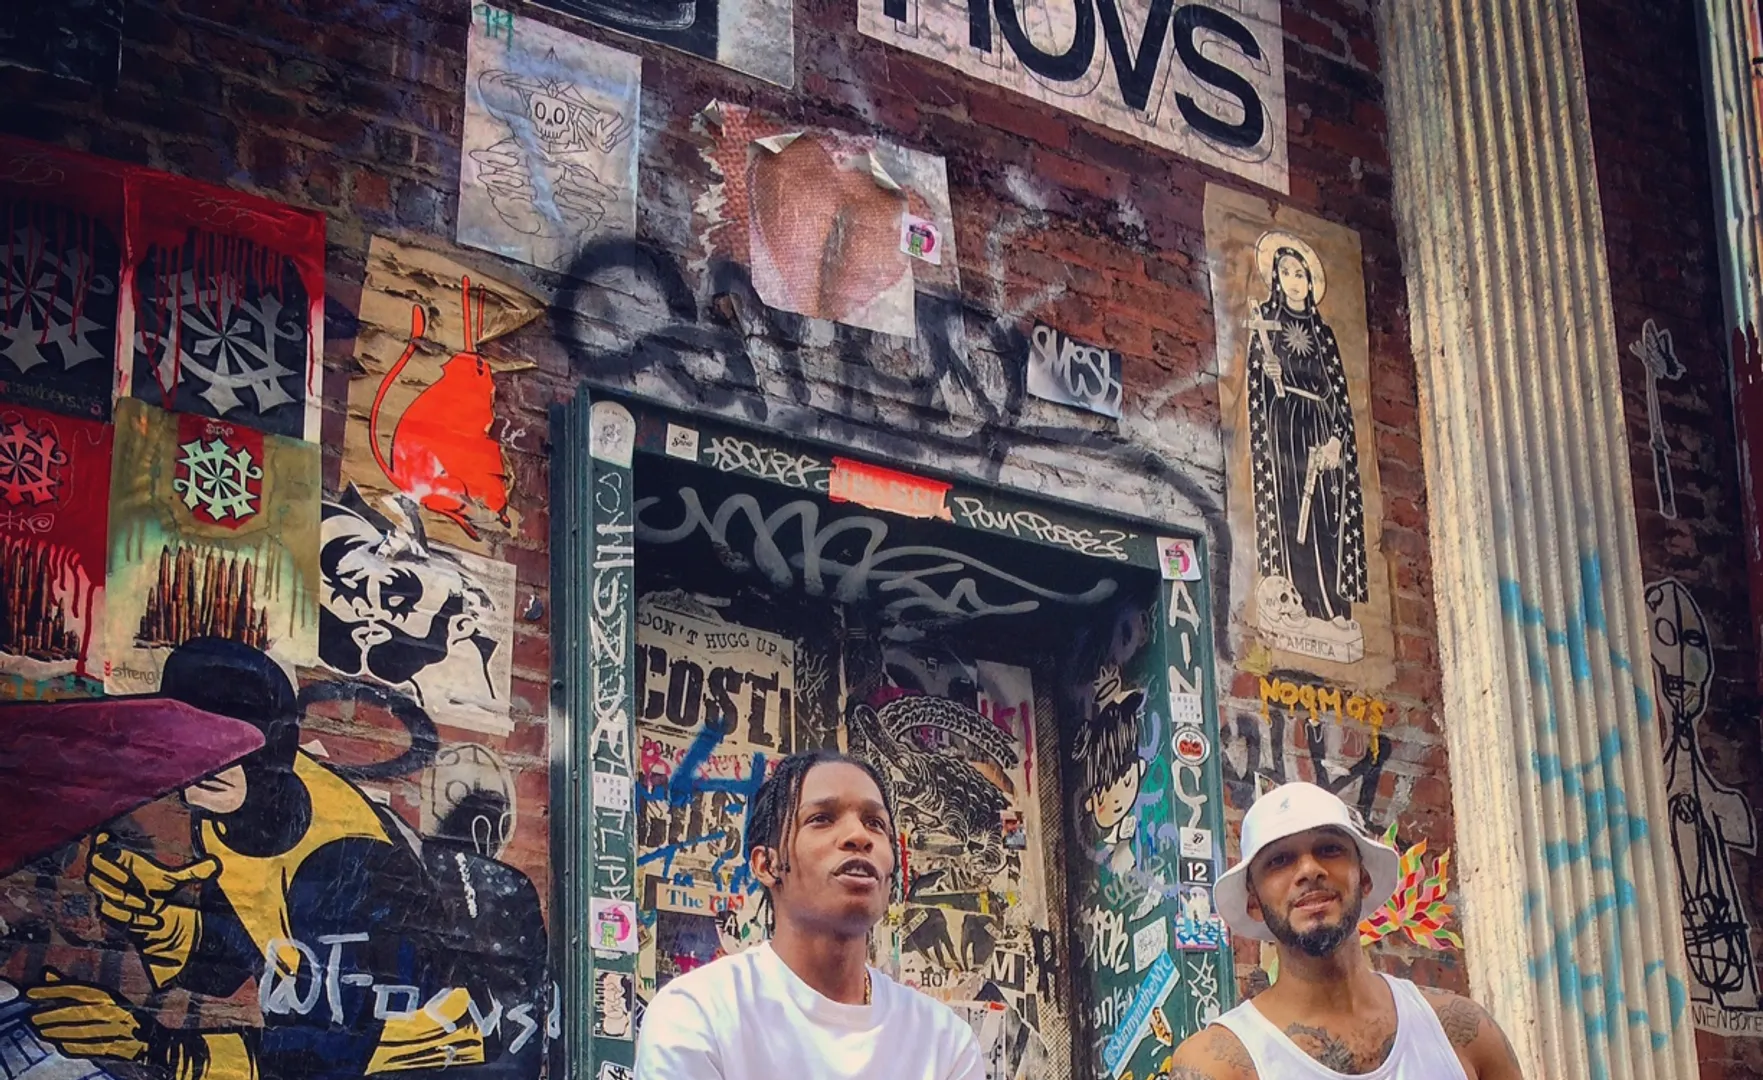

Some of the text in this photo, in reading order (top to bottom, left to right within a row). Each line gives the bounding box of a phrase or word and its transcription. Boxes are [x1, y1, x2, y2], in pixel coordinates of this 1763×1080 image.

[704, 632, 750, 650] HUGG
[756, 637, 778, 657] UP
[1287, 637, 1336, 657] AMERICA
[1187, 862, 1208, 881] 12
[666, 889, 703, 908] The
